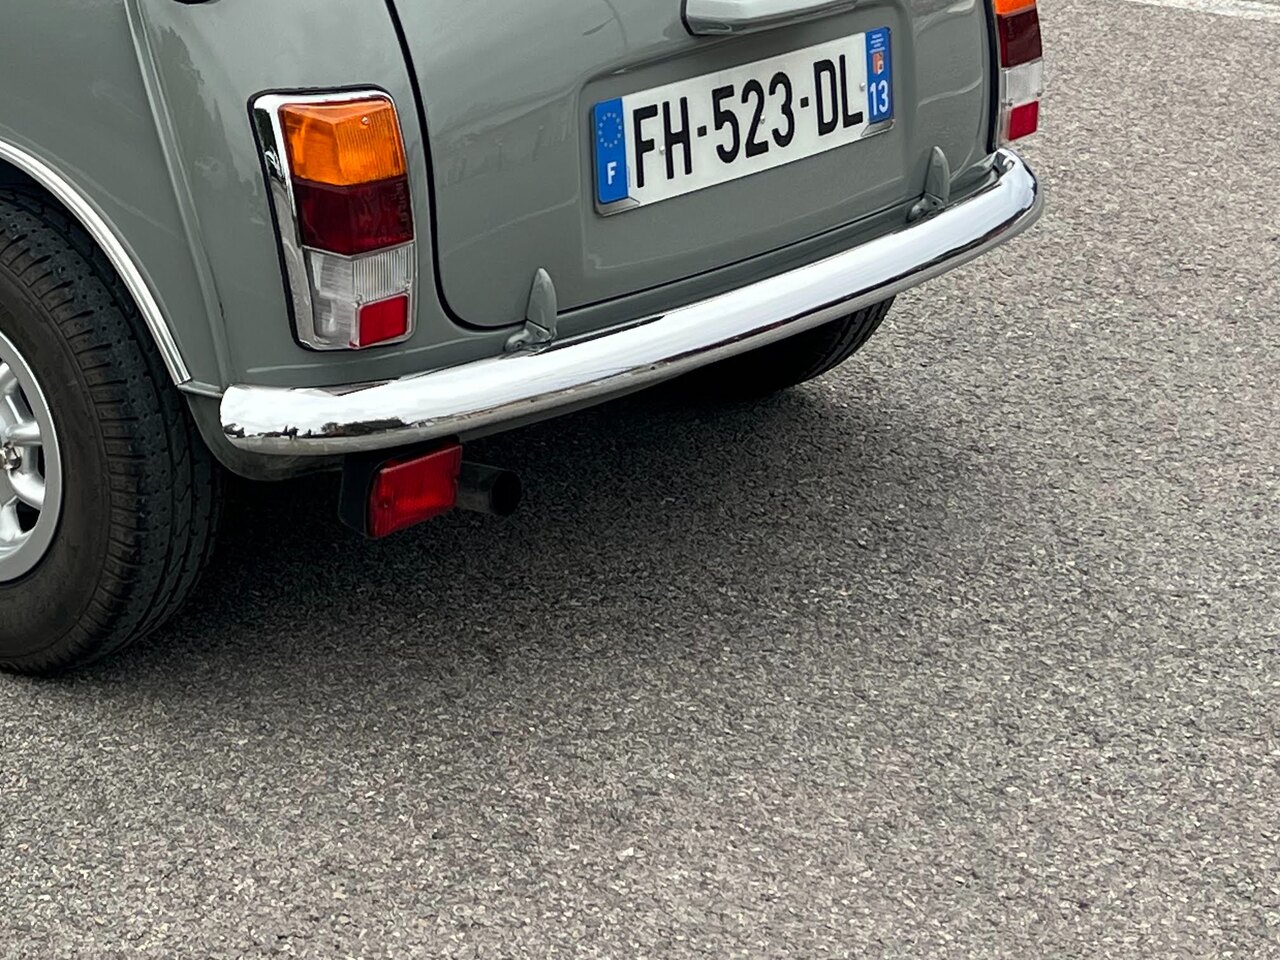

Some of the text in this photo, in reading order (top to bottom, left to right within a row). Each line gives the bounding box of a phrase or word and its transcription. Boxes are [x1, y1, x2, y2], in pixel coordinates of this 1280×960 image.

[869, 80, 890, 117] 13
[632, 54, 864, 188] FH-523-DL
[607, 161, 617, 184] F
